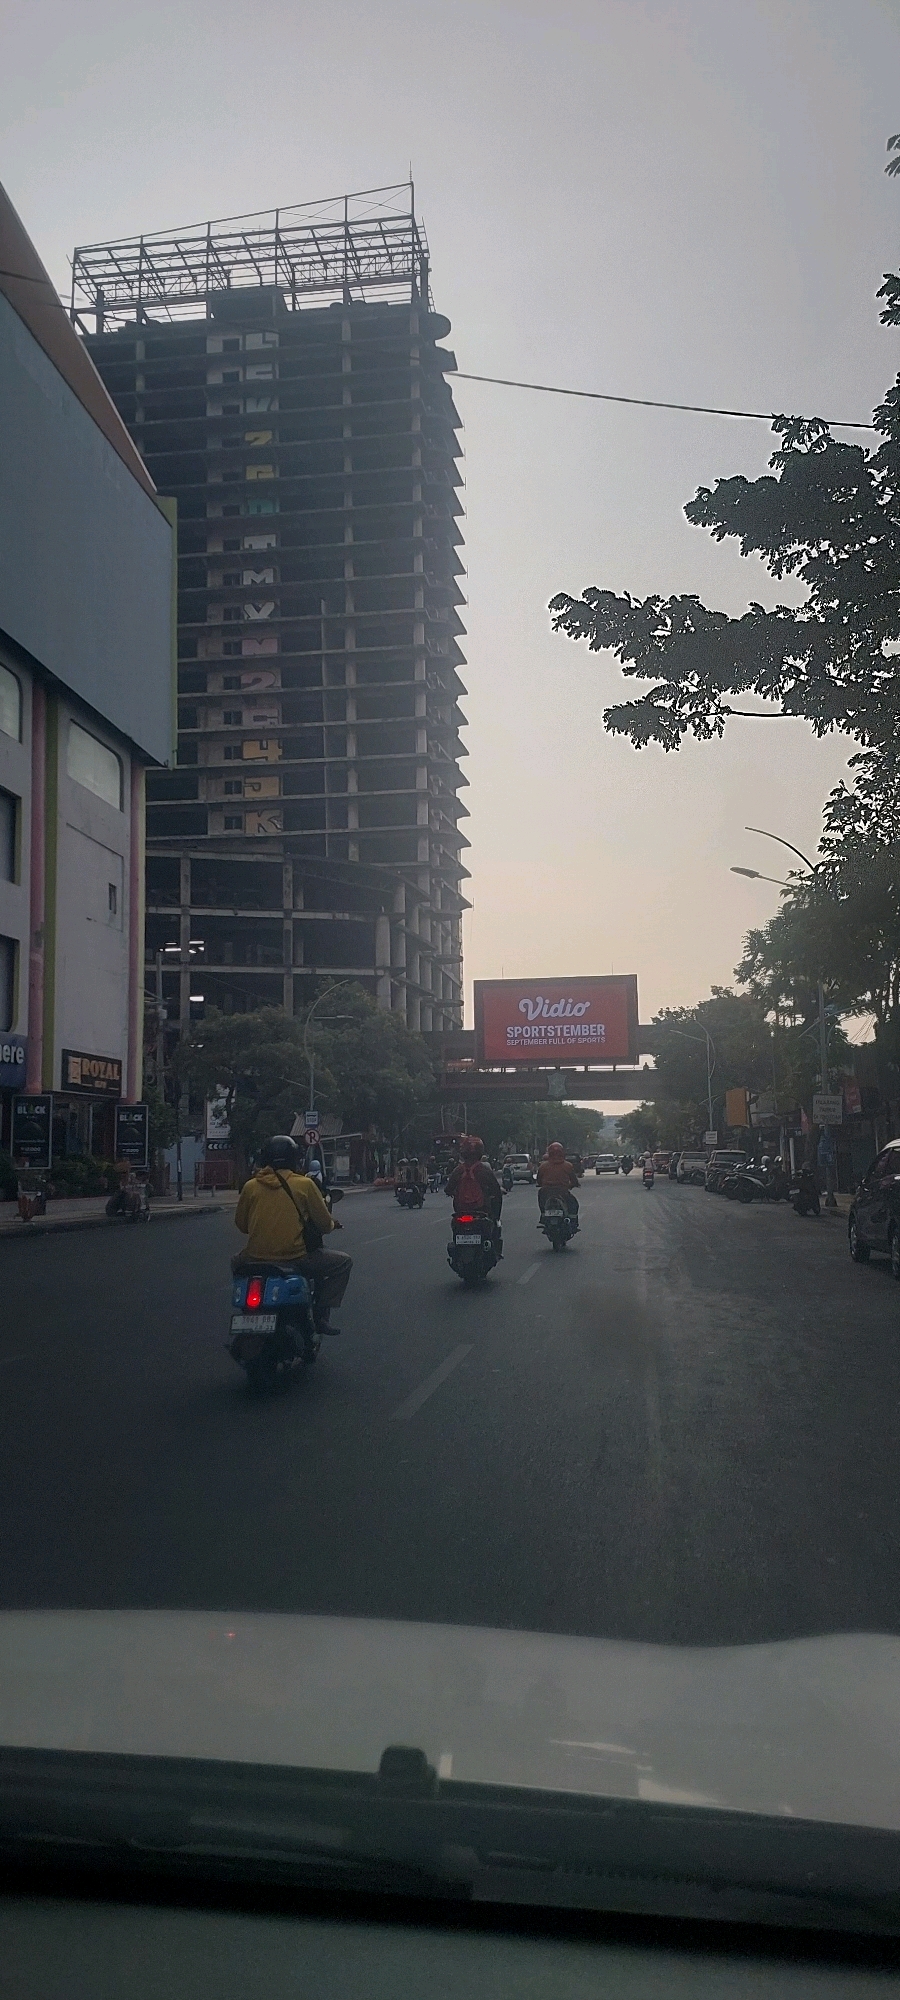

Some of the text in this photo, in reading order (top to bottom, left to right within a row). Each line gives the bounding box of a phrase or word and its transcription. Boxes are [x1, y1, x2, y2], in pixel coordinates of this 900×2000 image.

[518, 996, 591, 1021] Vidio
[506, 1024, 605, 1038] SPORTSTEMBER
[506, 1038, 548, 1046] SEPTEMBER
[577, 1036, 606, 1044] SPORTS
[81, 1058, 119, 1081] ROYAL
